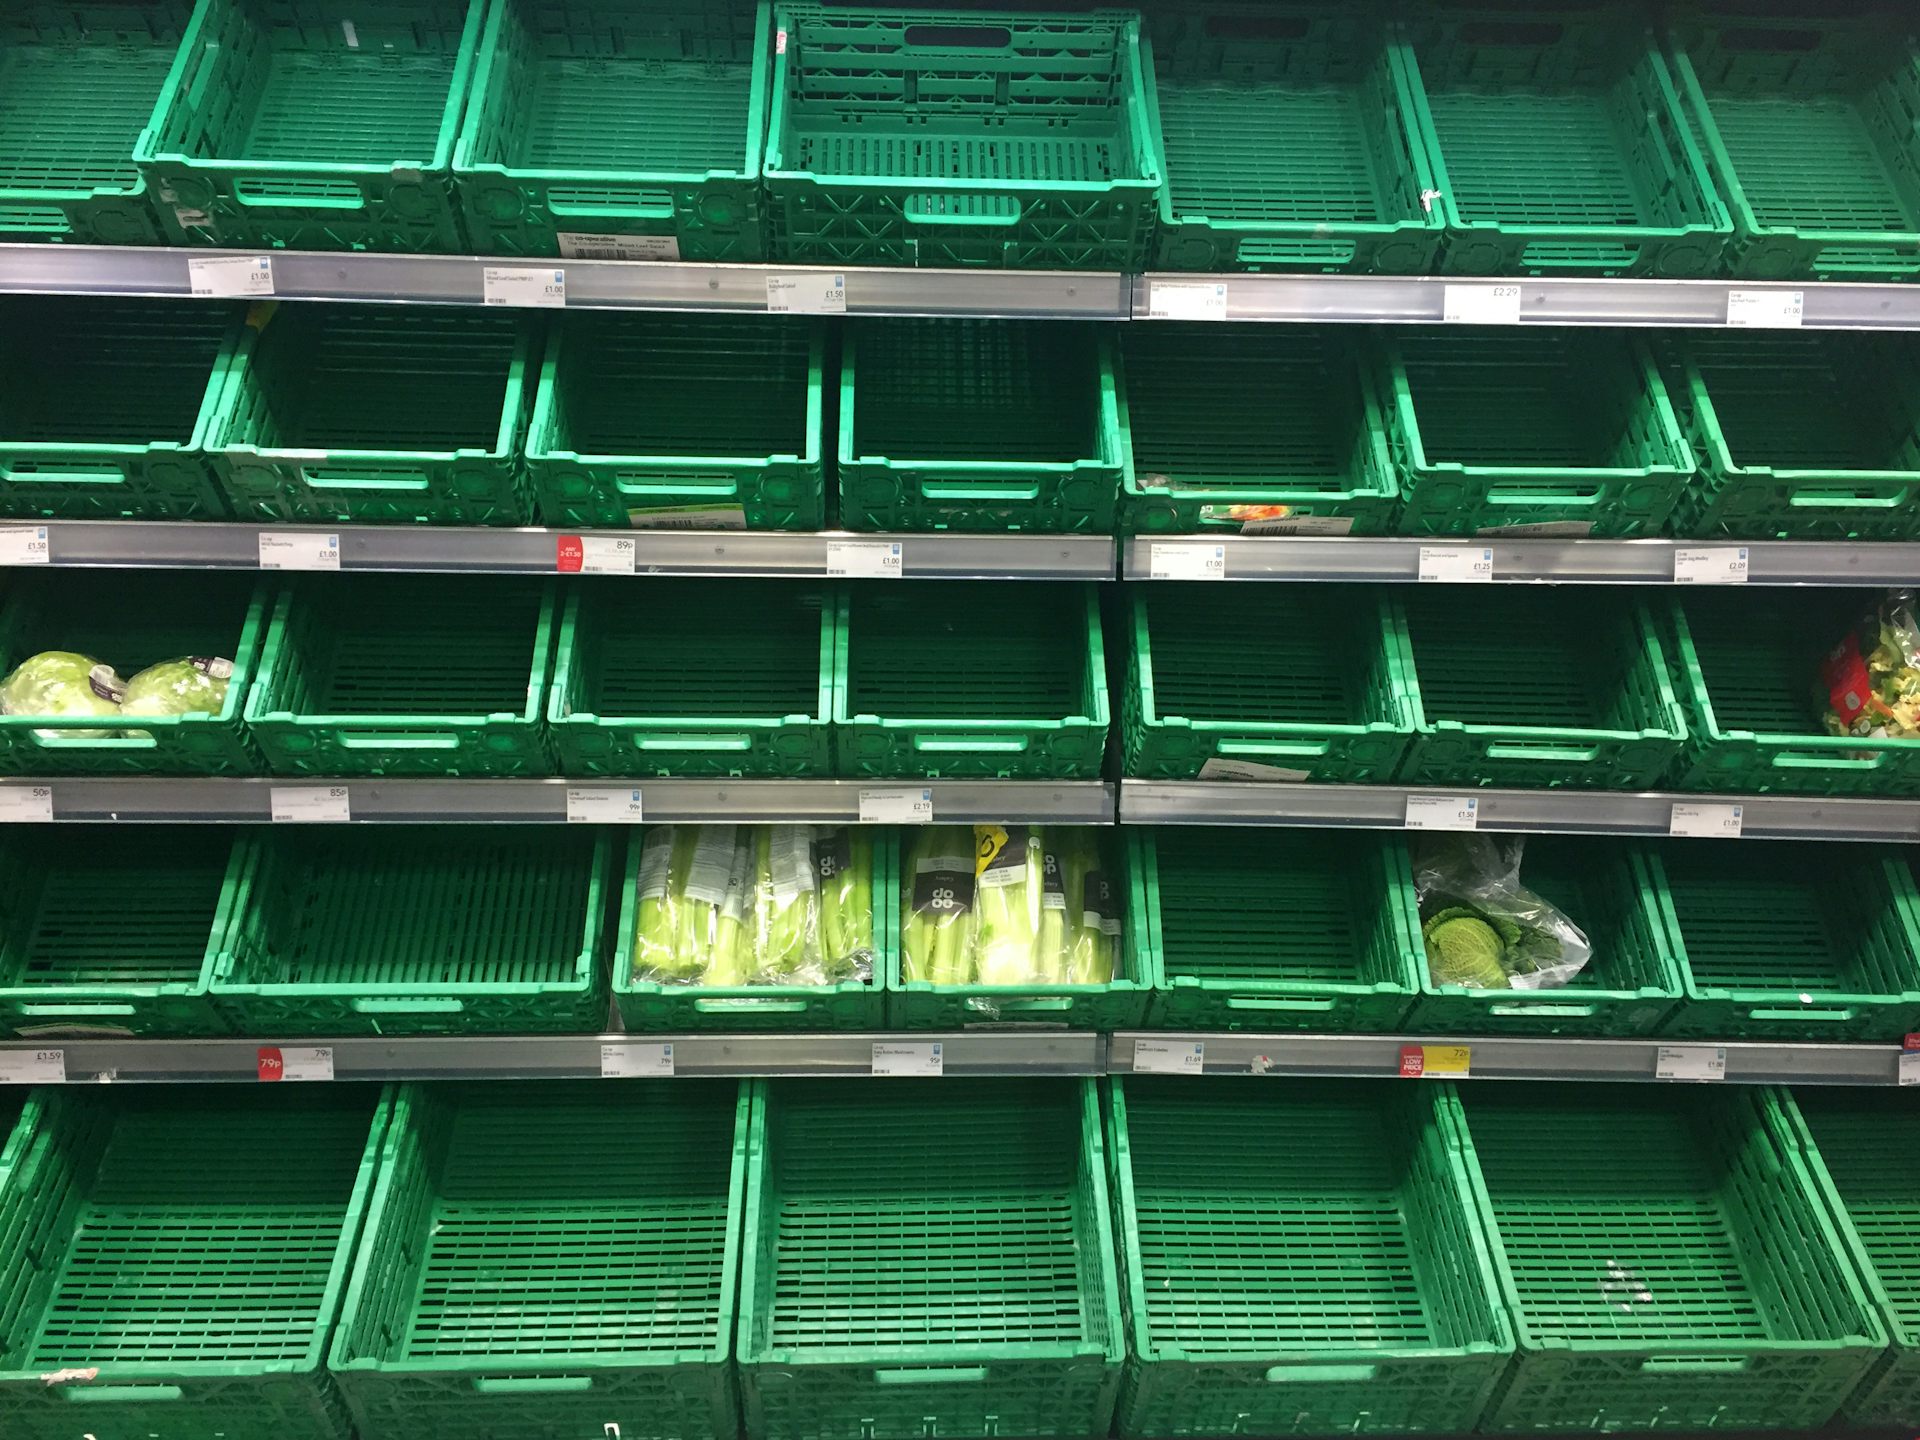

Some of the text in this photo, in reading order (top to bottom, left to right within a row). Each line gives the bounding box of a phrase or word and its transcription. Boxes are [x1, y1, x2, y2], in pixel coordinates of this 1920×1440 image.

[251, 272, 270, 281] £1.00
[545, 286, 563, 294] £1.00
[825, 290, 843, 299] £1.50
[1783, 307, 1800, 315] £1.00
[28, 542, 46, 550] £1.50
[617, 540, 633, 550] 89p
[319, 550, 337, 558] £1.00
[883, 557, 900, 565] £1.00
[1206, 560, 1223, 568] £1.00
[1474, 563, 1491, 571] £1.25
[1729, 562, 1746, 570] £2.09
[33, 788, 49, 797] 50p
[330, 788, 346, 797] 85p
[629, 803, 640, 811] 99p
[913, 803, 930, 811] £2.19
[1458, 811, 1474, 819] £1.50
[1723, 819, 1739, 827] £1.00
[37, 1052, 61, 1060] £1.59
[315, 1049, 331, 1058] 79p
[1454, 1049, 1468, 1057] 72p
[260, 1058, 281, 1069] 79p
[661, 1057, 671, 1066] 79p
[930, 1057, 941, 1065] 95p
[1708, 1061, 1724, 1069] £1.00
